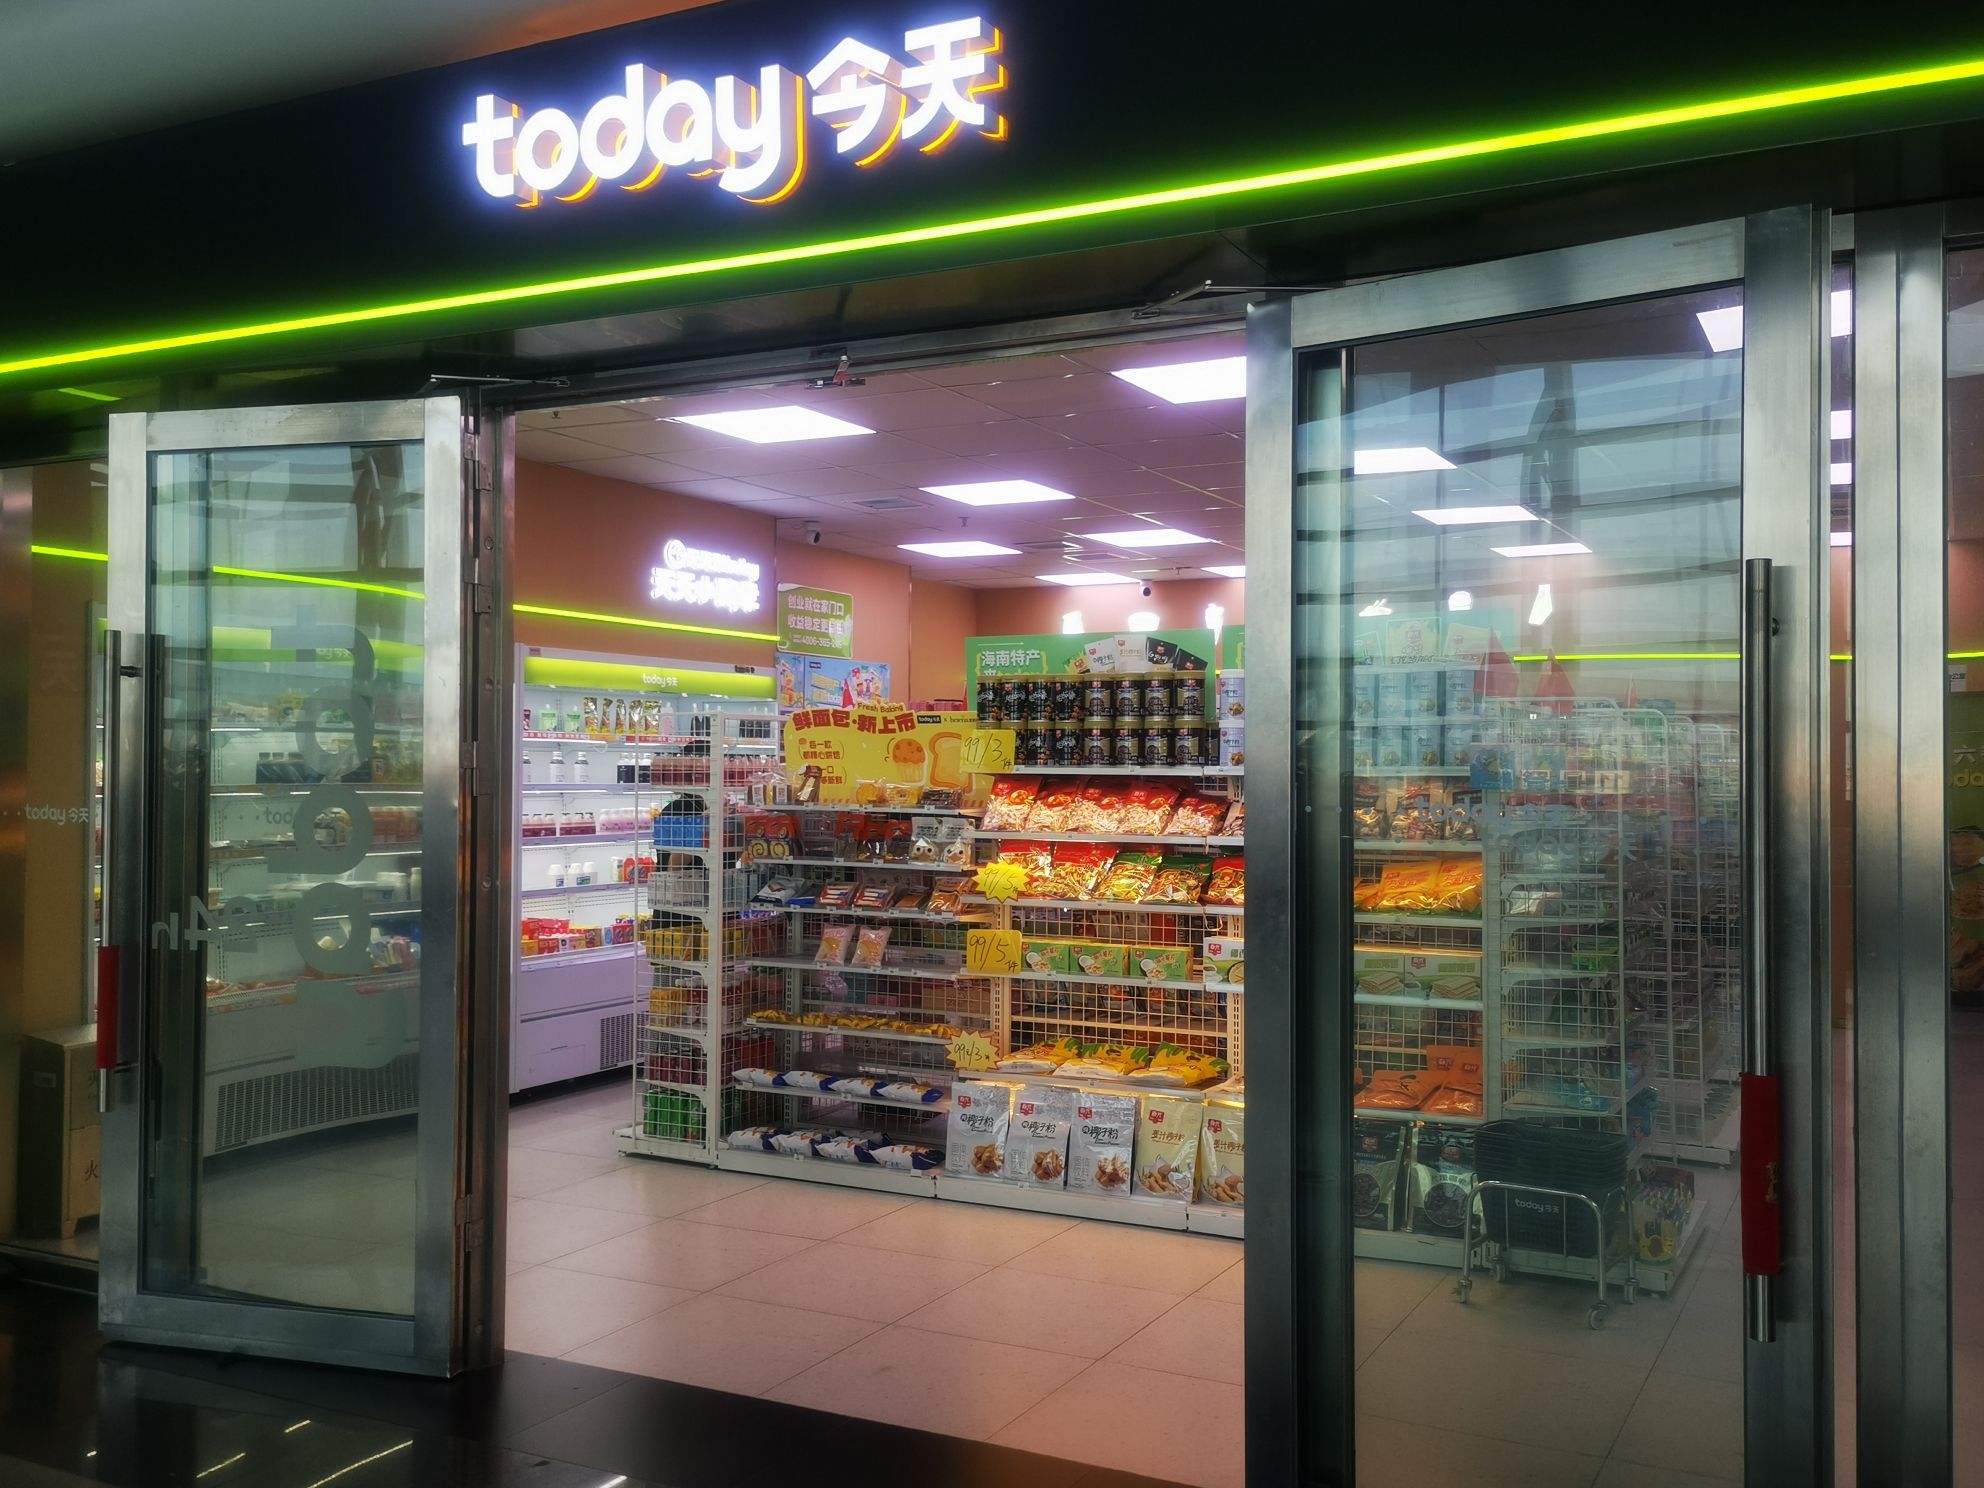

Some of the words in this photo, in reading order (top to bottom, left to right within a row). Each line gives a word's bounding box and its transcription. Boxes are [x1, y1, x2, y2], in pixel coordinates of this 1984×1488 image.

[462, 62, 790, 200] today
[806, 16, 992, 158] 今天
[788, 594, 844, 616] 创业就在家门口
[981, 649, 1041, 667] 海南特产
[642, 673, 666, 687] today
[857, 703, 878, 712] Fresh
[24, 803, 66, 826] today
[68, 807, 89, 823] 今天
[1515, 1198, 1544, 1213] today
